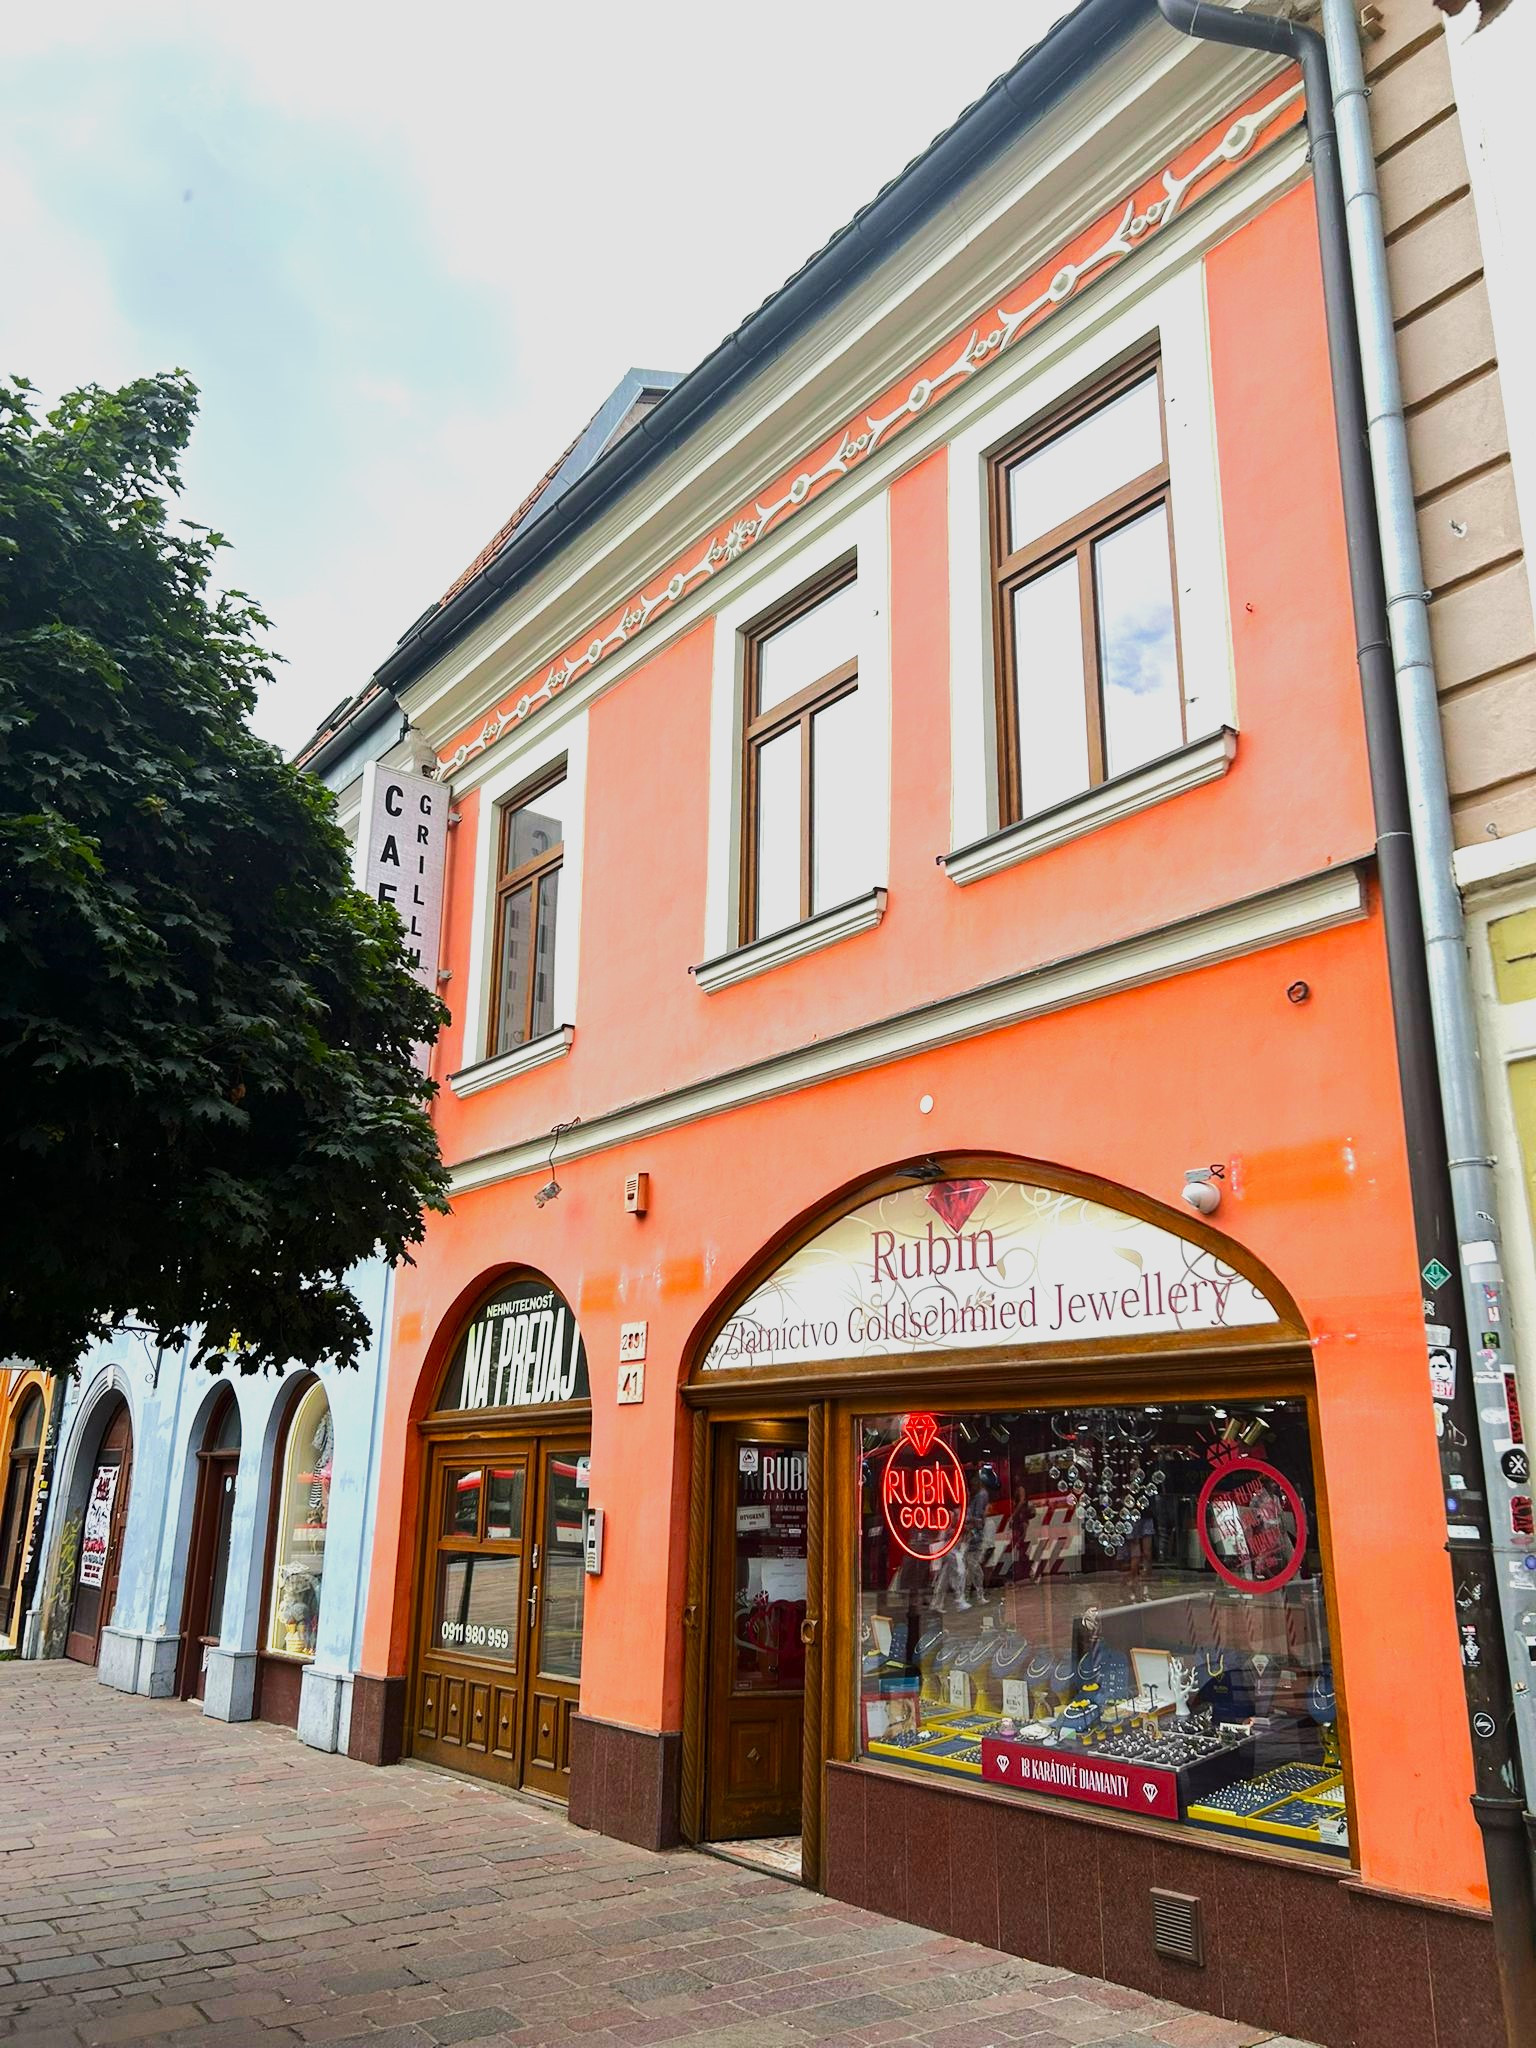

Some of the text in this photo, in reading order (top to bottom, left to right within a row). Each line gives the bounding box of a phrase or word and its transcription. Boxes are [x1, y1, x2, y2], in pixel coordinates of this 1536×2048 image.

[486, 1290, 555, 1318] NEHNUTEĽNOSŤ
[724, 1271, 1234, 1356] Zlatníctvo Goldschmied Jewellery
[459, 1306, 581, 1411] NA PREDAJ
[622, 1371, 638, 1396] 41
[900, 1506, 951, 1530] GOLD
[441, 1620, 509, 1649] 0911 980 959
[1020, 1757, 1129, 1798] 18 KARÁTOVÉ DIAMANTY
